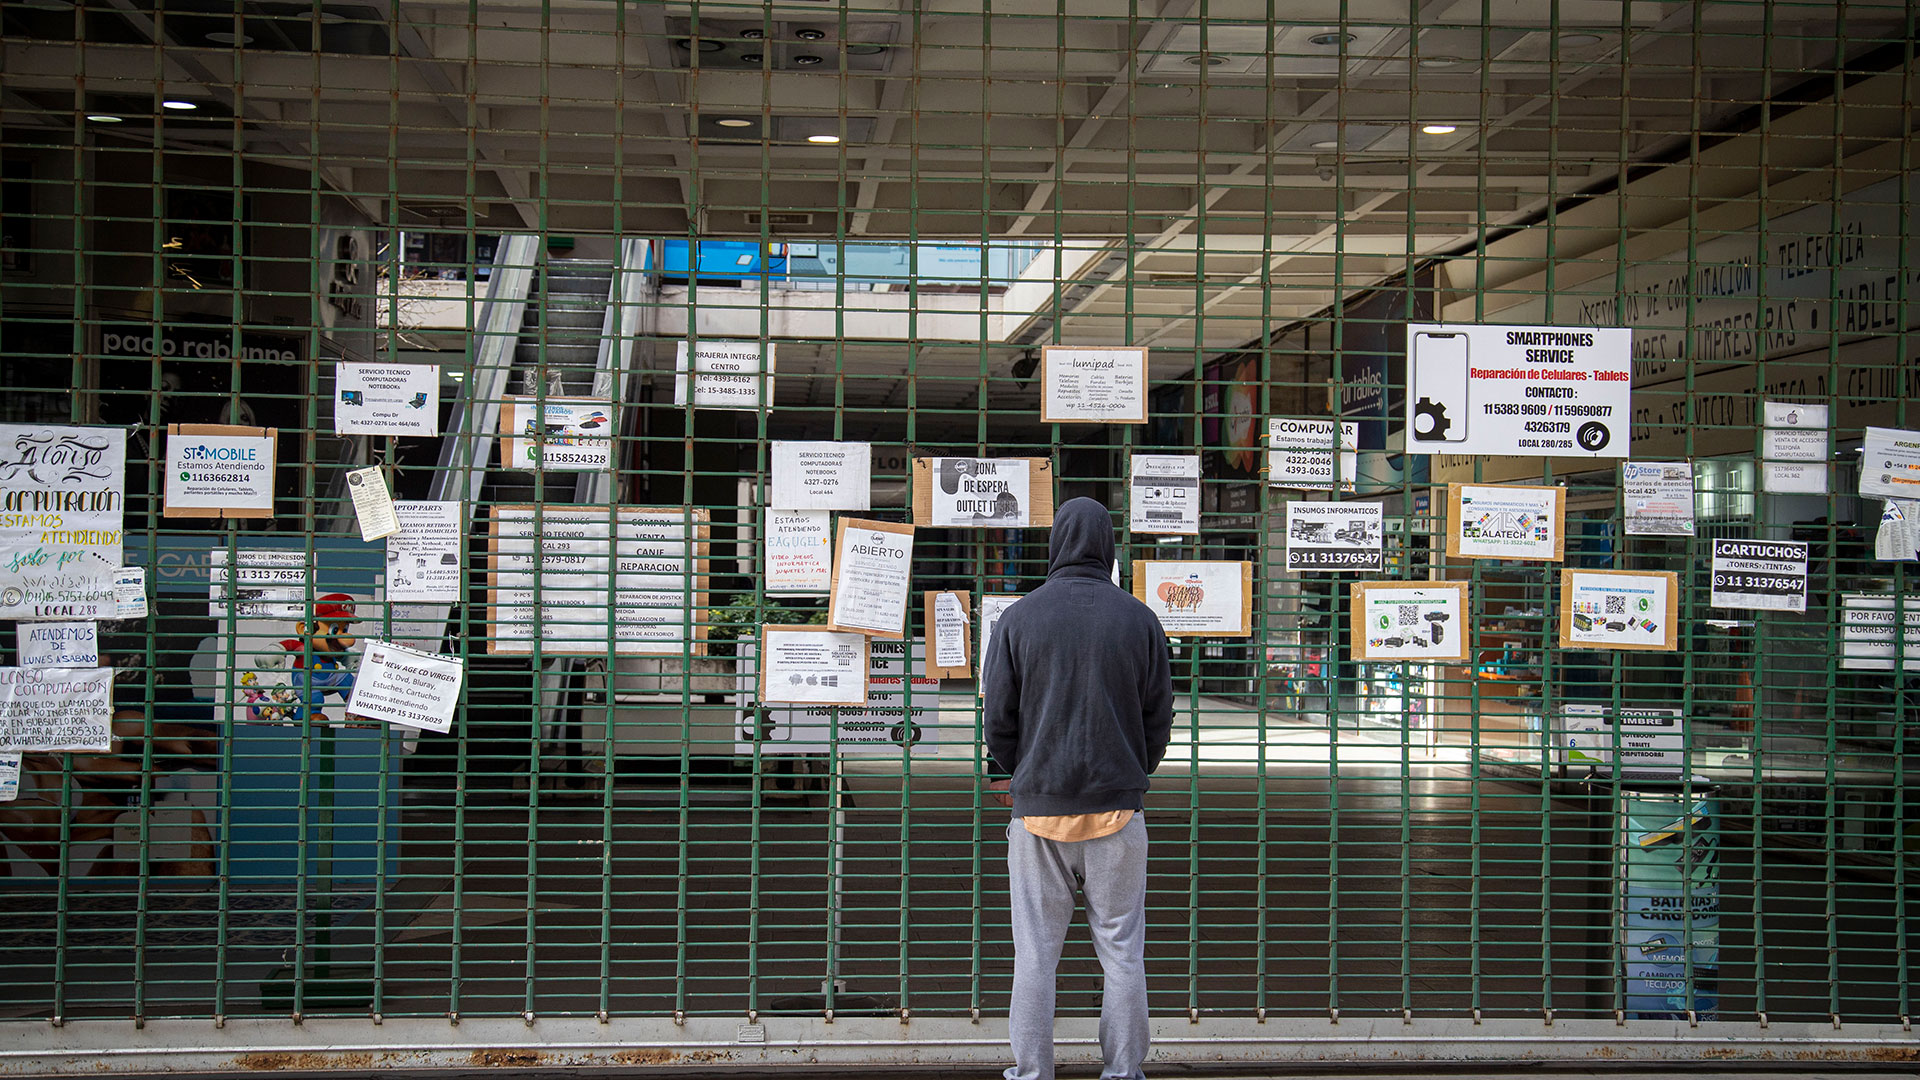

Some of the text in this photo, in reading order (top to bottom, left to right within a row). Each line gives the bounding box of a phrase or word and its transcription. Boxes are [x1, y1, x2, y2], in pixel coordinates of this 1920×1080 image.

[1647, 284, 1659, 318] DE
[1506, 331, 1594, 347] SMARTPHONES
[1696, 302, 1797, 365] IMPRESRAS
[1525, 349, 1574, 364] SERVICE
[1072, 358, 1115, 371] lumipad
[1471, 368, 1629, 382] Reparación de Celulares Tablets
[708, 387, 756, 395] 15-3485-1335
[1524, 421, 1571, 434] 43263179
[1276, 435, 1305, 443] Estamos
[1518, 439, 1573, 449] LOCAL 280/285
[544, 453, 606, 464] 1158524328
[1286, 456, 1331, 465] 4322-0046
[177, 462, 265, 470] Estamos Atendiendo
[975, 462, 997, 475] ZONA
[1285, 466, 1331, 475] 4393-0633
[192, 473, 250, 482] 1163662814
[964, 481, 1009, 493] DE ESPERA
[956, 500, 988, 513] OUTLET
[1294, 507, 1379, 515] INSUMOS INFORMATICOS
[0, 514, 63, 528] ESTAMOS
[40, 530, 121, 545] ATENDIENDO
[1482, 530, 1527, 539] ALATECH
[851, 544, 904, 559] ABIERTO
[1717, 544, 1806, 559] ¿CARTUCHOS?
[1302, 553, 1380, 564] 11 31376547
[620, 562, 680, 572] REPARACION
[251, 571, 270, 579] 313
[274, 571, 306, 579] 76547
[1727, 576, 1804, 590] 11 31376547
[1168, 586, 1199, 595] ESTAMOS
[35, 605, 97, 616] LOCAL 288
[1851, 612, 1869, 620] POR
[30, 628, 94, 642] ATENDEMOS
[50, 642, 66, 650] DE
[23, 655, 53, 665] LUNES
[62, 654, 97, 662] SABADO
[384, 661, 402, 670] NEW
[430, 671, 456, 683] VIRGEN
[383, 671, 436, 690] Cd, Dvd, Bluray,
[373, 681, 441, 702] Estuches, Cartuchos
[22, 702, 39, 710] QUE
[59, 699, 105, 708] LLAMADOS
[358, 689, 428, 711] Estamos atendiendo
[34, 707, 108, 717] NO INGRESAN POR
[356, 700, 443, 725] WHATSAPP 15 31376029
[12, 720, 23, 728] EN
[26, 718, 70, 727] SUBSUELO
[12, 725, 105, 736] LLAMAR AL 21505382
[1570, 739, 1576, 747] 6
[1645, 980, 1684, 989] TECLADO
